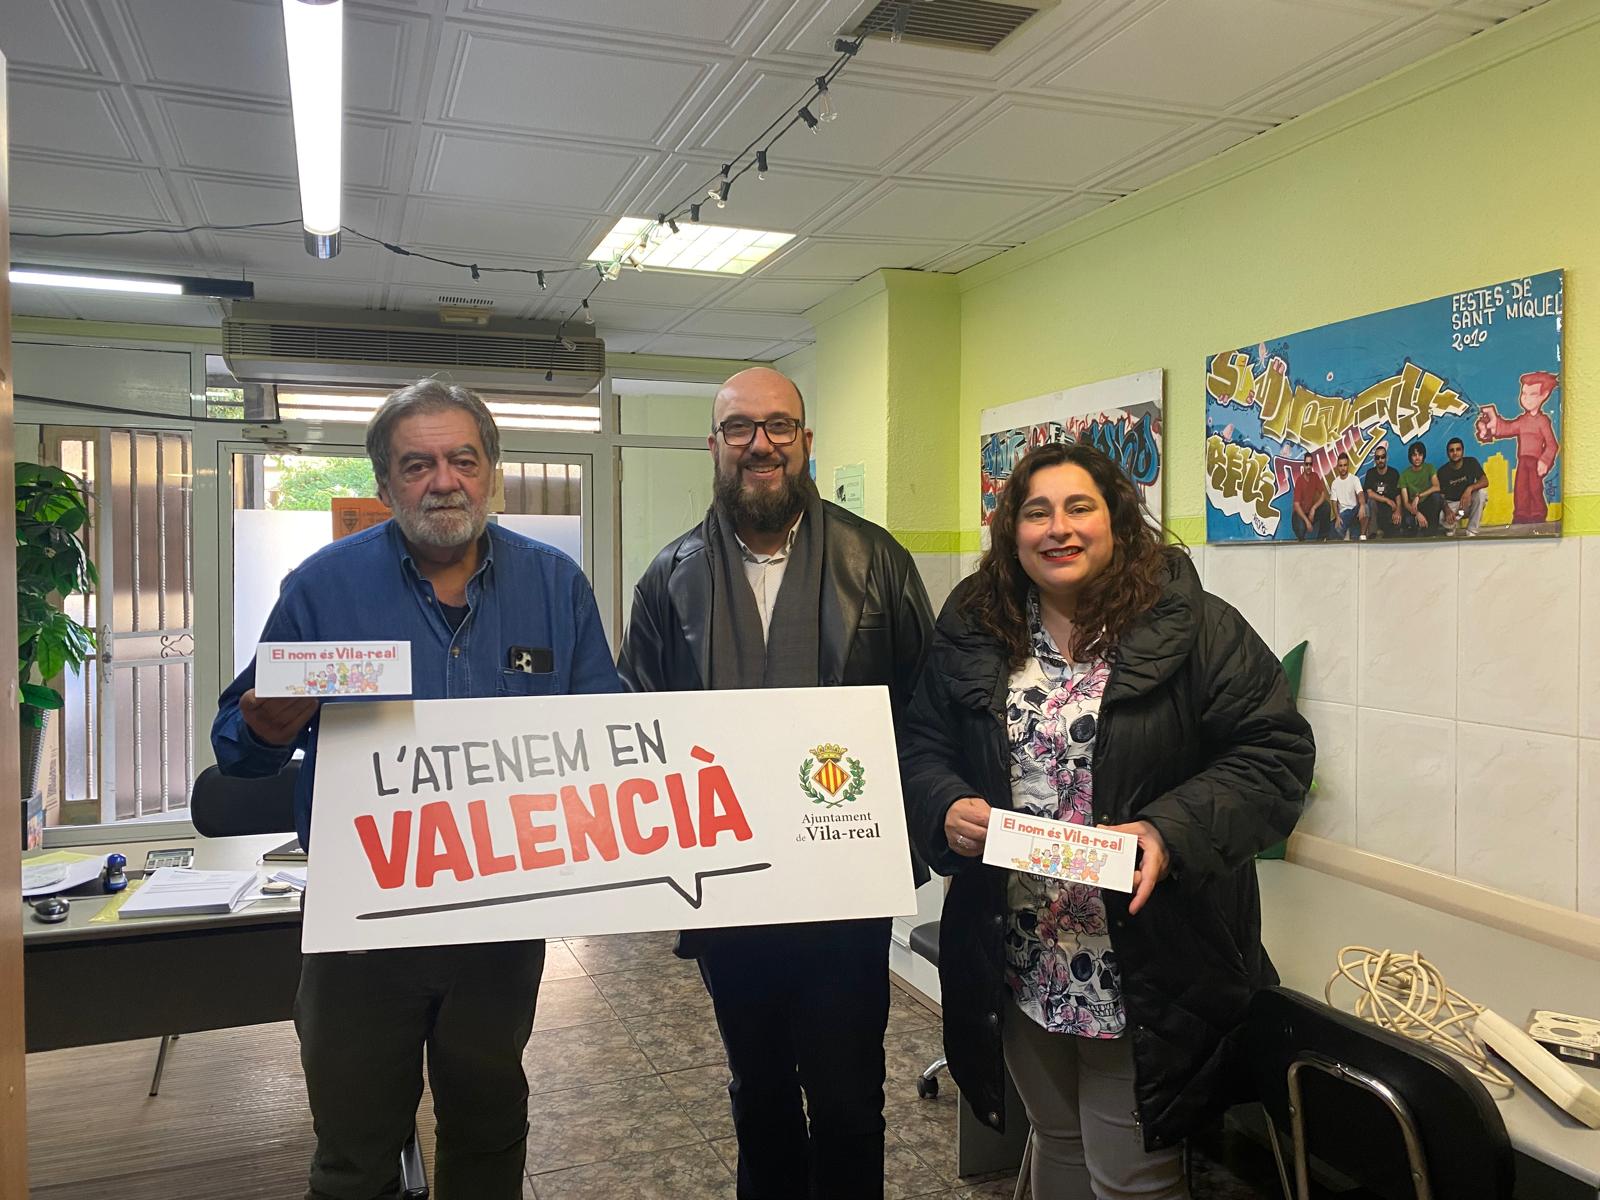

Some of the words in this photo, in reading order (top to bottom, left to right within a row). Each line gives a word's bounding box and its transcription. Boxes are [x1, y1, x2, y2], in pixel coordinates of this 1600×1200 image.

[1452, 308, 1495, 330] SANT
[1506, 294, 1562, 320] MIQUEL
[1453, 286, 1504, 312] FESTES
[1511, 278, 1532, 299] DE
[1452, 329, 1488, 351] 2010
[272, 649, 285, 660] El
[288, 650, 317, 660] nom
[320, 649, 334, 660] és
[335, 646, 397, 660] Vila-real
[372, 728, 589, 796] L'ATENEM
[606, 719, 666, 768] EN
[354, 745, 754, 889] VALENCIÀ
[796, 833, 806, 842] de
[805, 823, 881, 841] Vila-real
[802, 812, 872, 826] Ajuntament
[1003, 817, 1015, 830] El
[1018, 824, 1044, 836] nom
[1047, 826, 1061, 840] és
[1063, 828, 1123, 851] Vila-real
